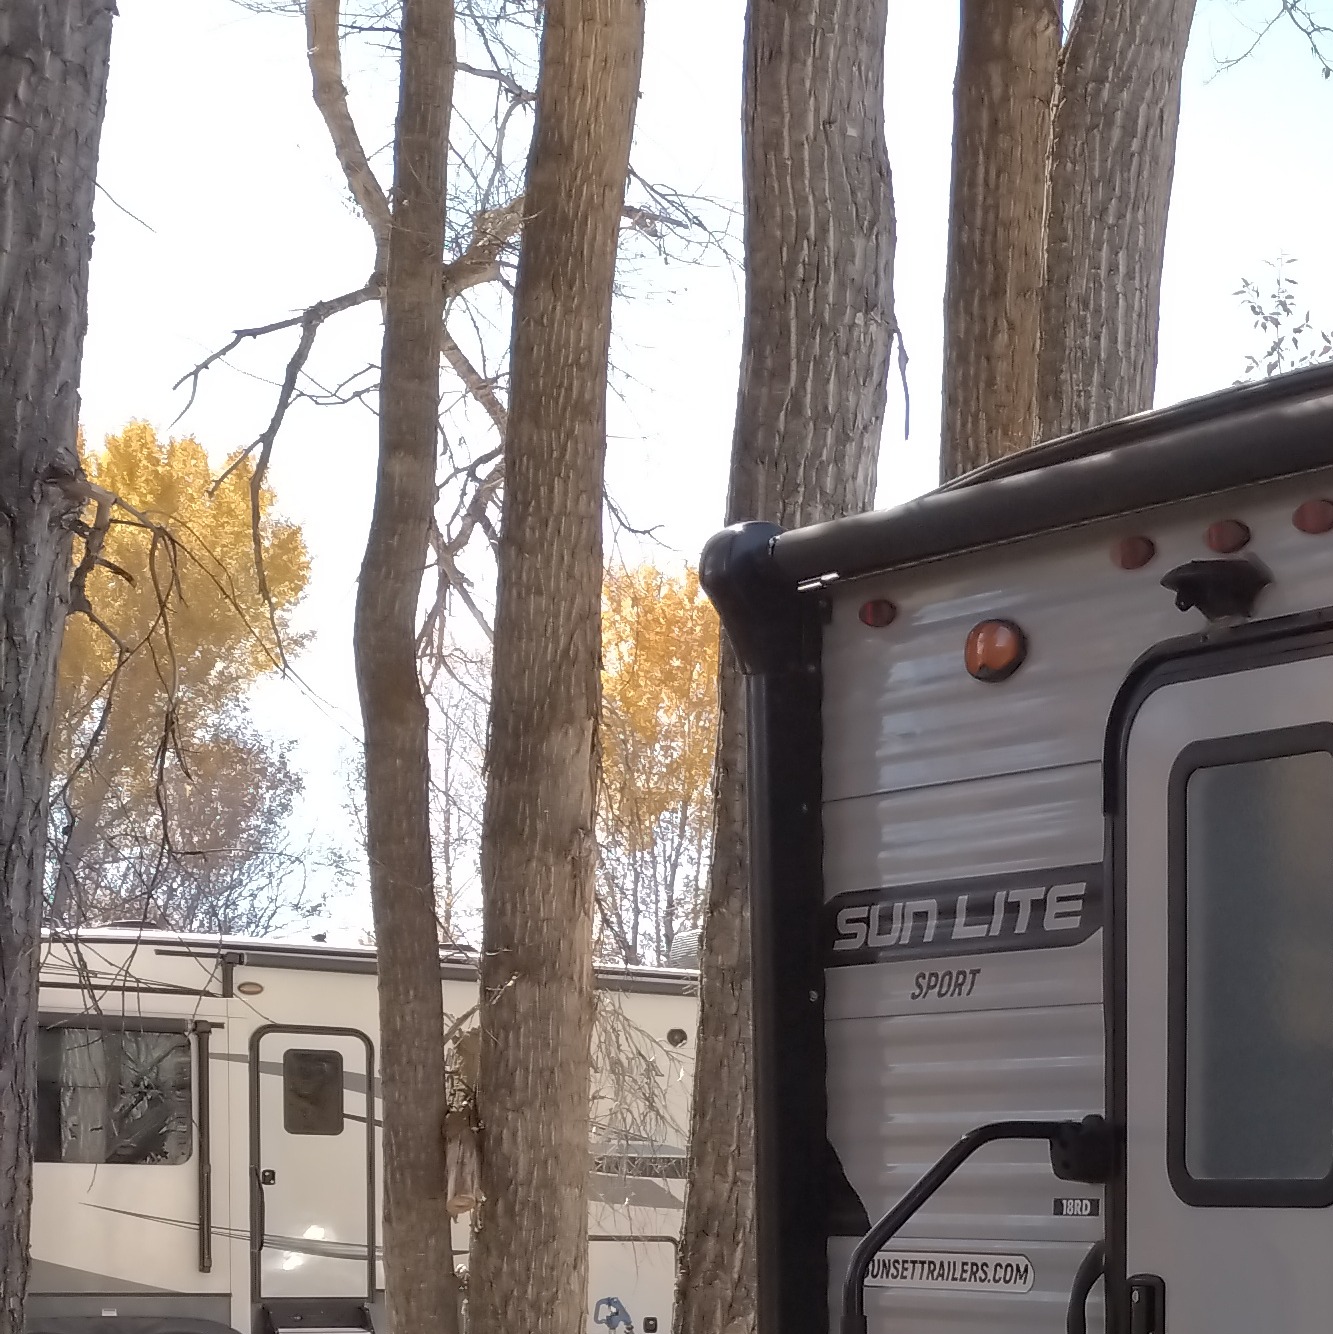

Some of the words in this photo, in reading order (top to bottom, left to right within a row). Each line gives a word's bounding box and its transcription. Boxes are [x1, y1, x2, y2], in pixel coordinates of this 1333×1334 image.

[833, 898, 938, 951] SUN
[952, 881, 1087, 940] LITE
[911, 968, 981, 1000] SPORT
[1062, 1199, 1091, 1216] 18RD
